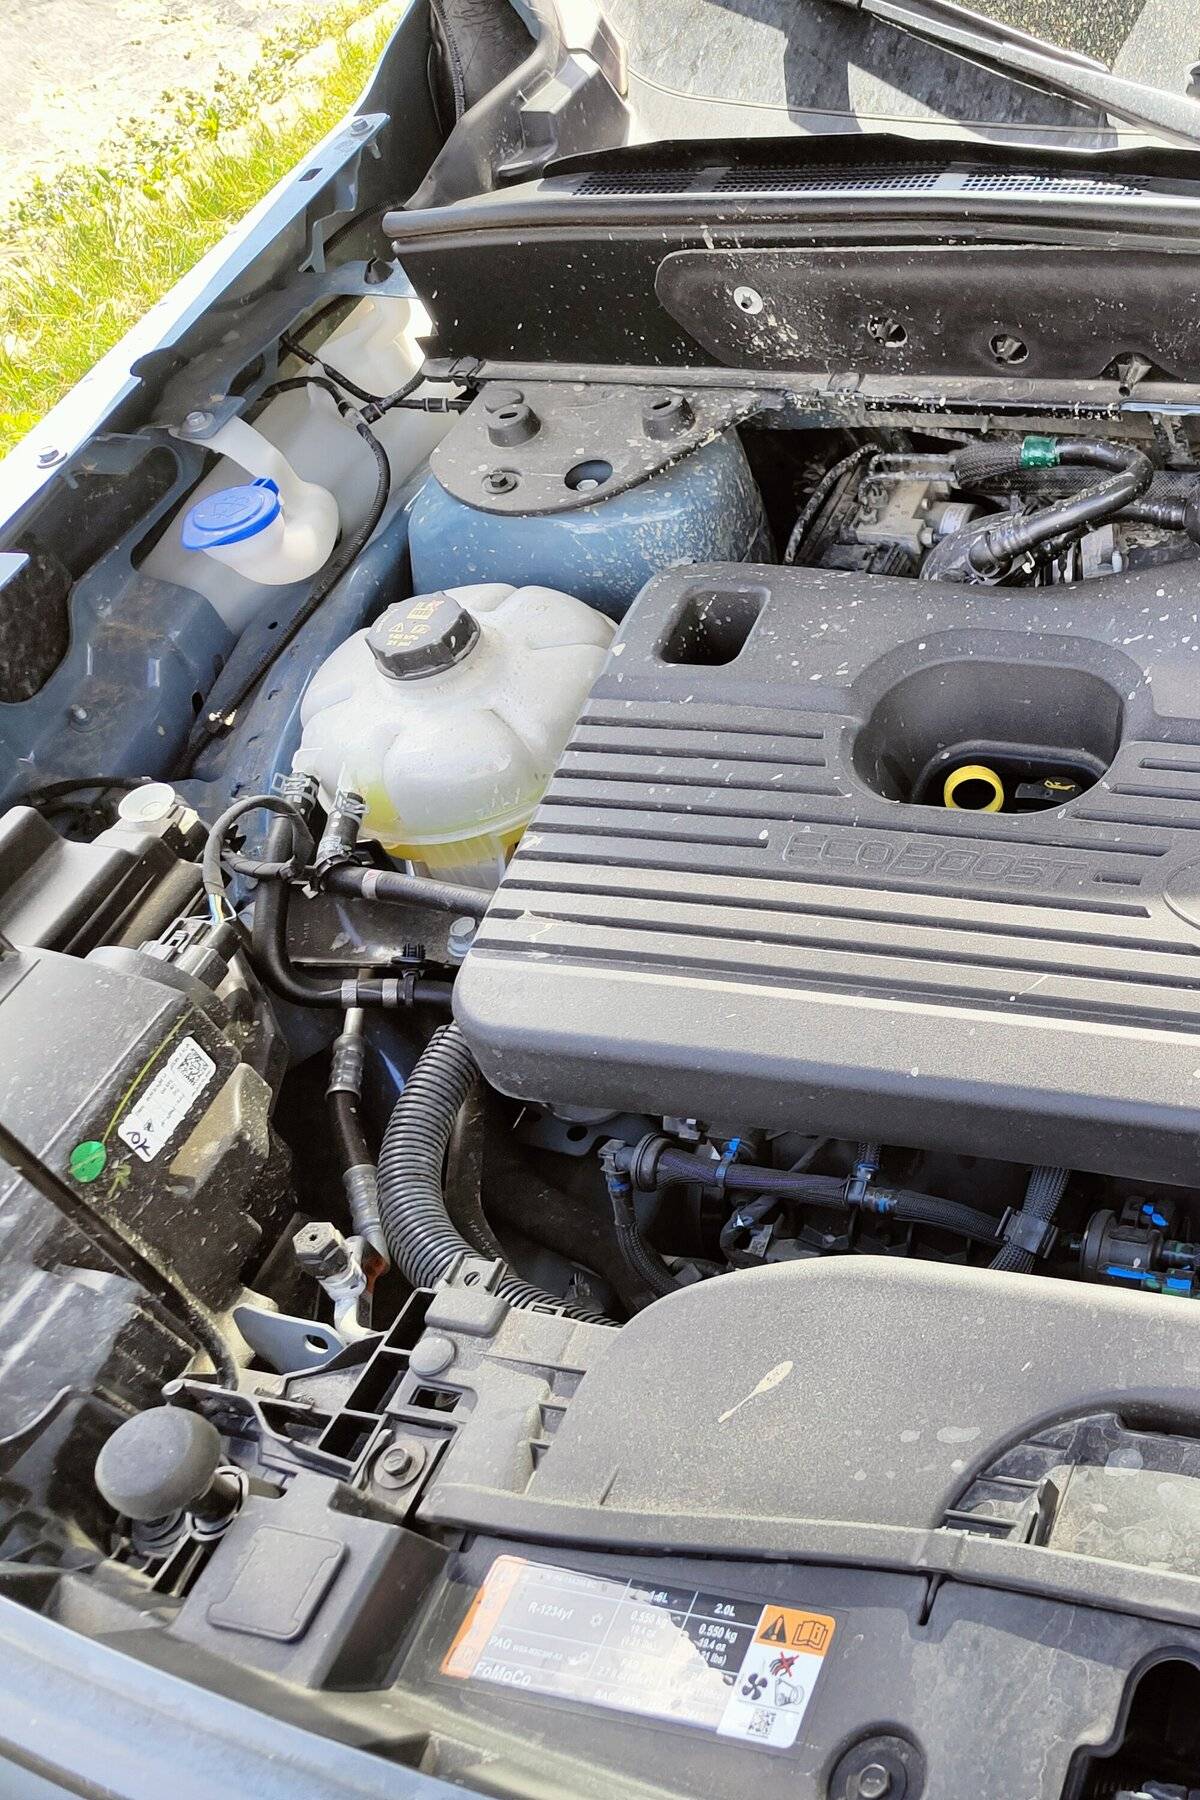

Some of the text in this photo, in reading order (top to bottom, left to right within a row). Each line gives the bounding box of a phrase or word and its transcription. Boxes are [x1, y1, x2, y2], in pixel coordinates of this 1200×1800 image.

[527, 1601, 575, 1621] R-1234yf
[714, 1603, 736, 1617] 2.0L
[698, 1623, 738, 1644] 0.550 kg
[699, 1637, 727, 1652] 19.4 oz
[472, 1661, 532, 1687] FoMoCo
